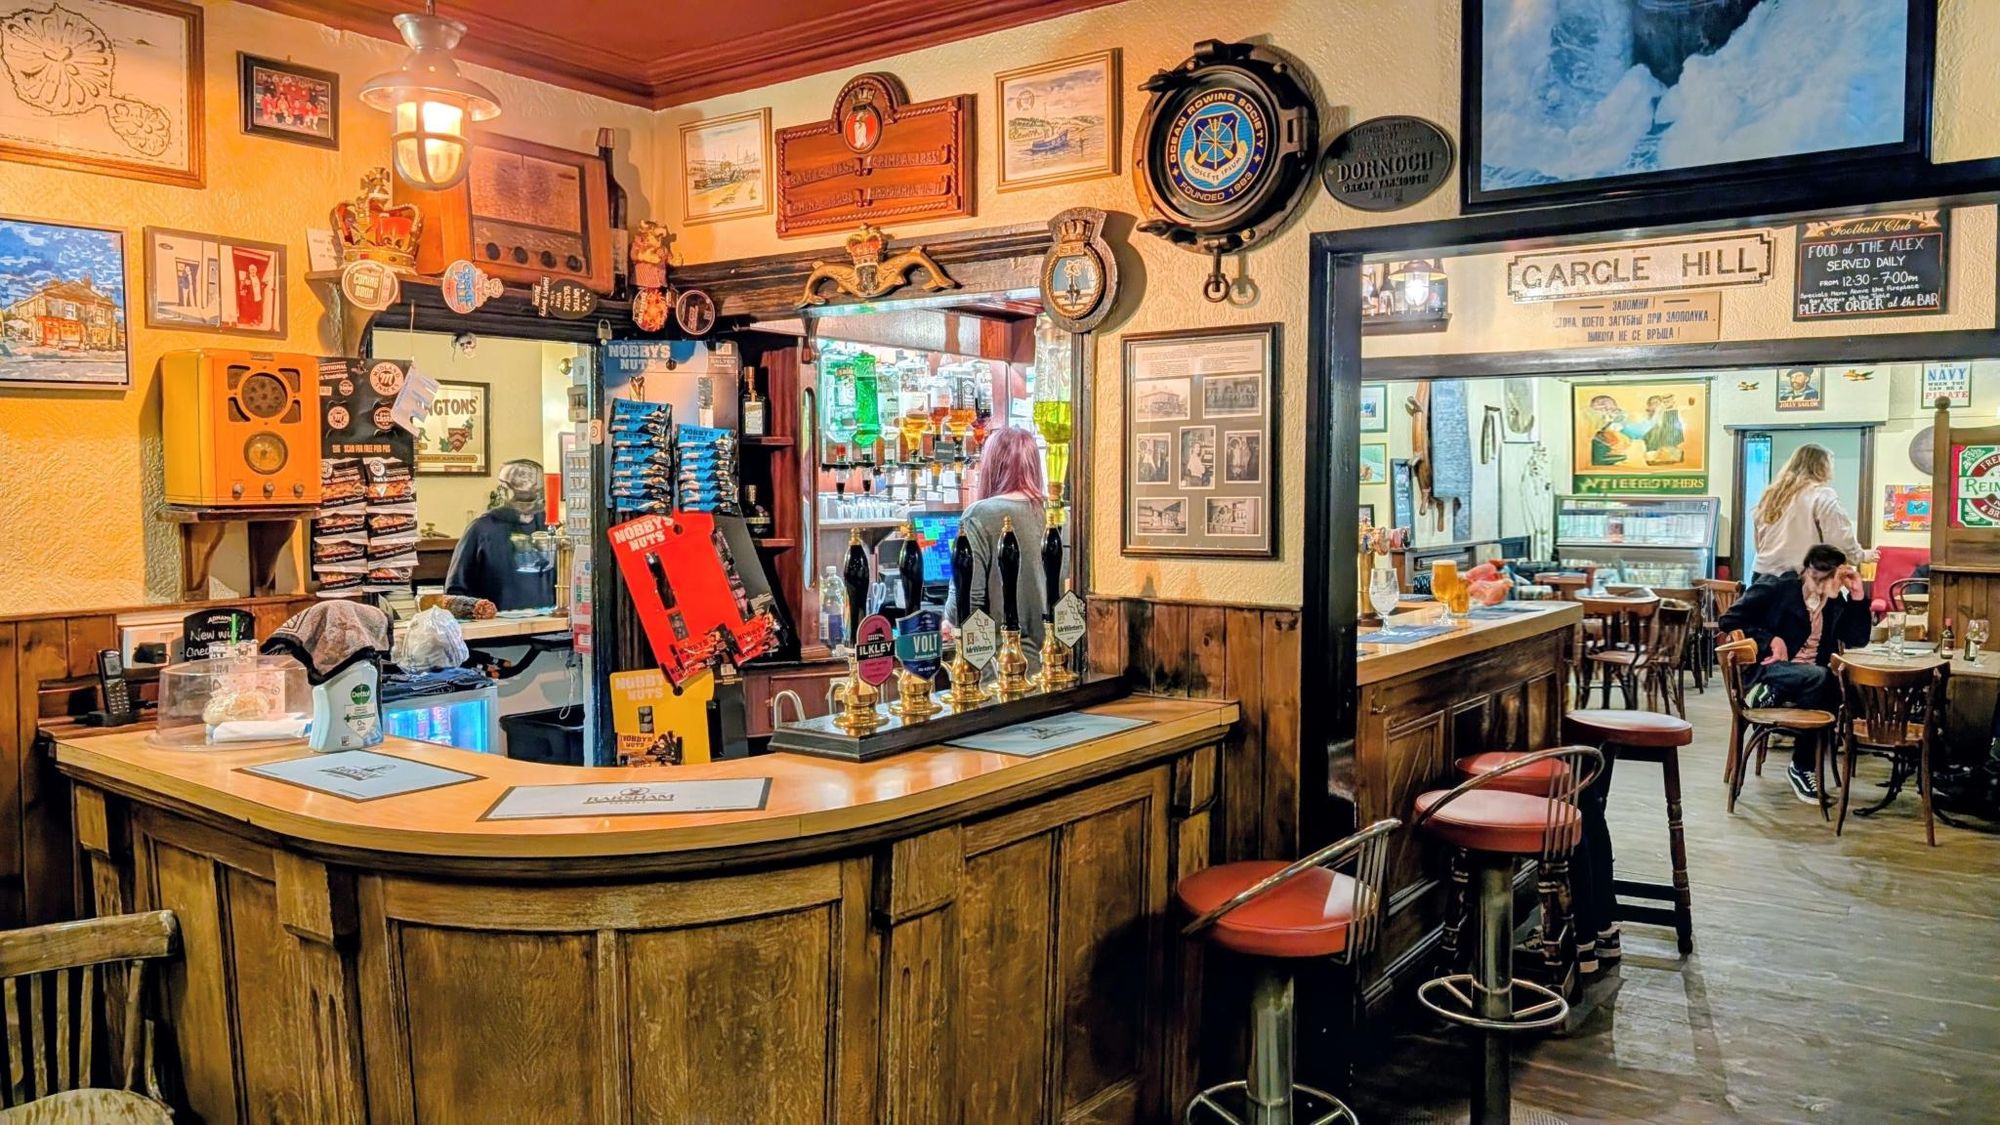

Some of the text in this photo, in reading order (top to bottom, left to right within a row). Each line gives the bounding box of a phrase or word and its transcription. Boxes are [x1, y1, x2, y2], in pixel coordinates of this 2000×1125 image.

[1170, 92, 1264, 163] OCEAN ROWING SOCIETY
[1337, 151, 1434, 183] DORNOCH
[1180, 172, 1253, 200] FOUNDED 1983
[1342, 174, 1429, 193] GREAT YARMOUTH
[1830, 219, 1912, 237] Football Club
[1808, 237, 1925, 258] FOOD at THE ALEX
[1521, 247, 1757, 289] GARGLE HILL
[1826, 255, 1906, 272] SERVED DAILY
[1800, 293, 1938, 315] PLEASE ORDER at the BAR
[1582, 314, 1604, 327] КОЕТО
[1647, 311, 1662, 324] ПРИ
[1618, 330, 1627, 341] НЕ
[1632, 329, 1641, 341] СЕ
[608, 344, 671, 358] NOBBY'S
[620, 358, 657, 370] NUTS
[1928, 368, 1967, 381] NAVY
[424, 395, 478, 416] NGTONS'
[614, 515, 675, 544] NOBBY'S
[629, 530, 666, 552] NUTS
[189, 628, 215, 642] New
[913, 633, 938, 653] VOLT
[859, 642, 893, 656] ILKLEY
[627, 686, 664, 700] NUTS
